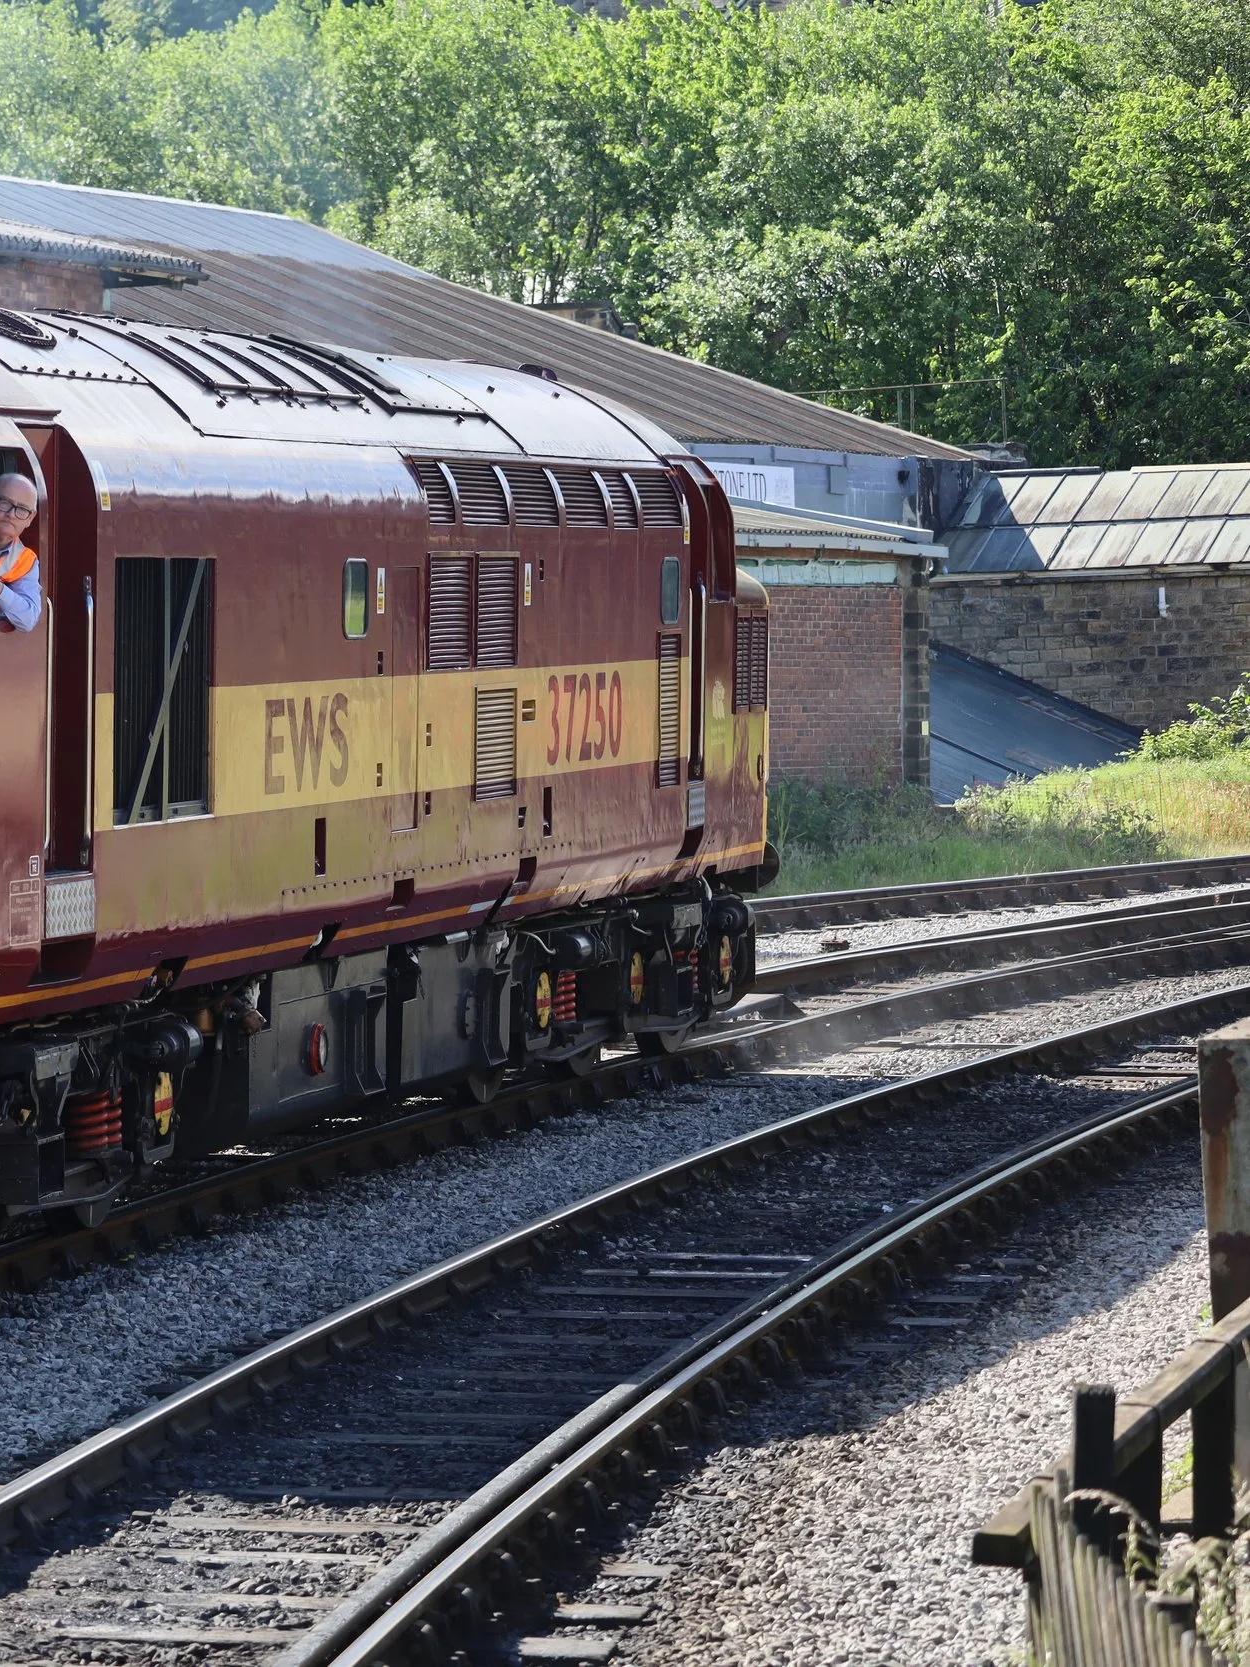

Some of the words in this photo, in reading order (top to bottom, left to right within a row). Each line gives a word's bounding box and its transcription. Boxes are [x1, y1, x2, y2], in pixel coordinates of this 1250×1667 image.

[747, 472, 766, 501] LTD
[265, 692, 349, 795] EWS
[547, 670, 622, 766] 37250
